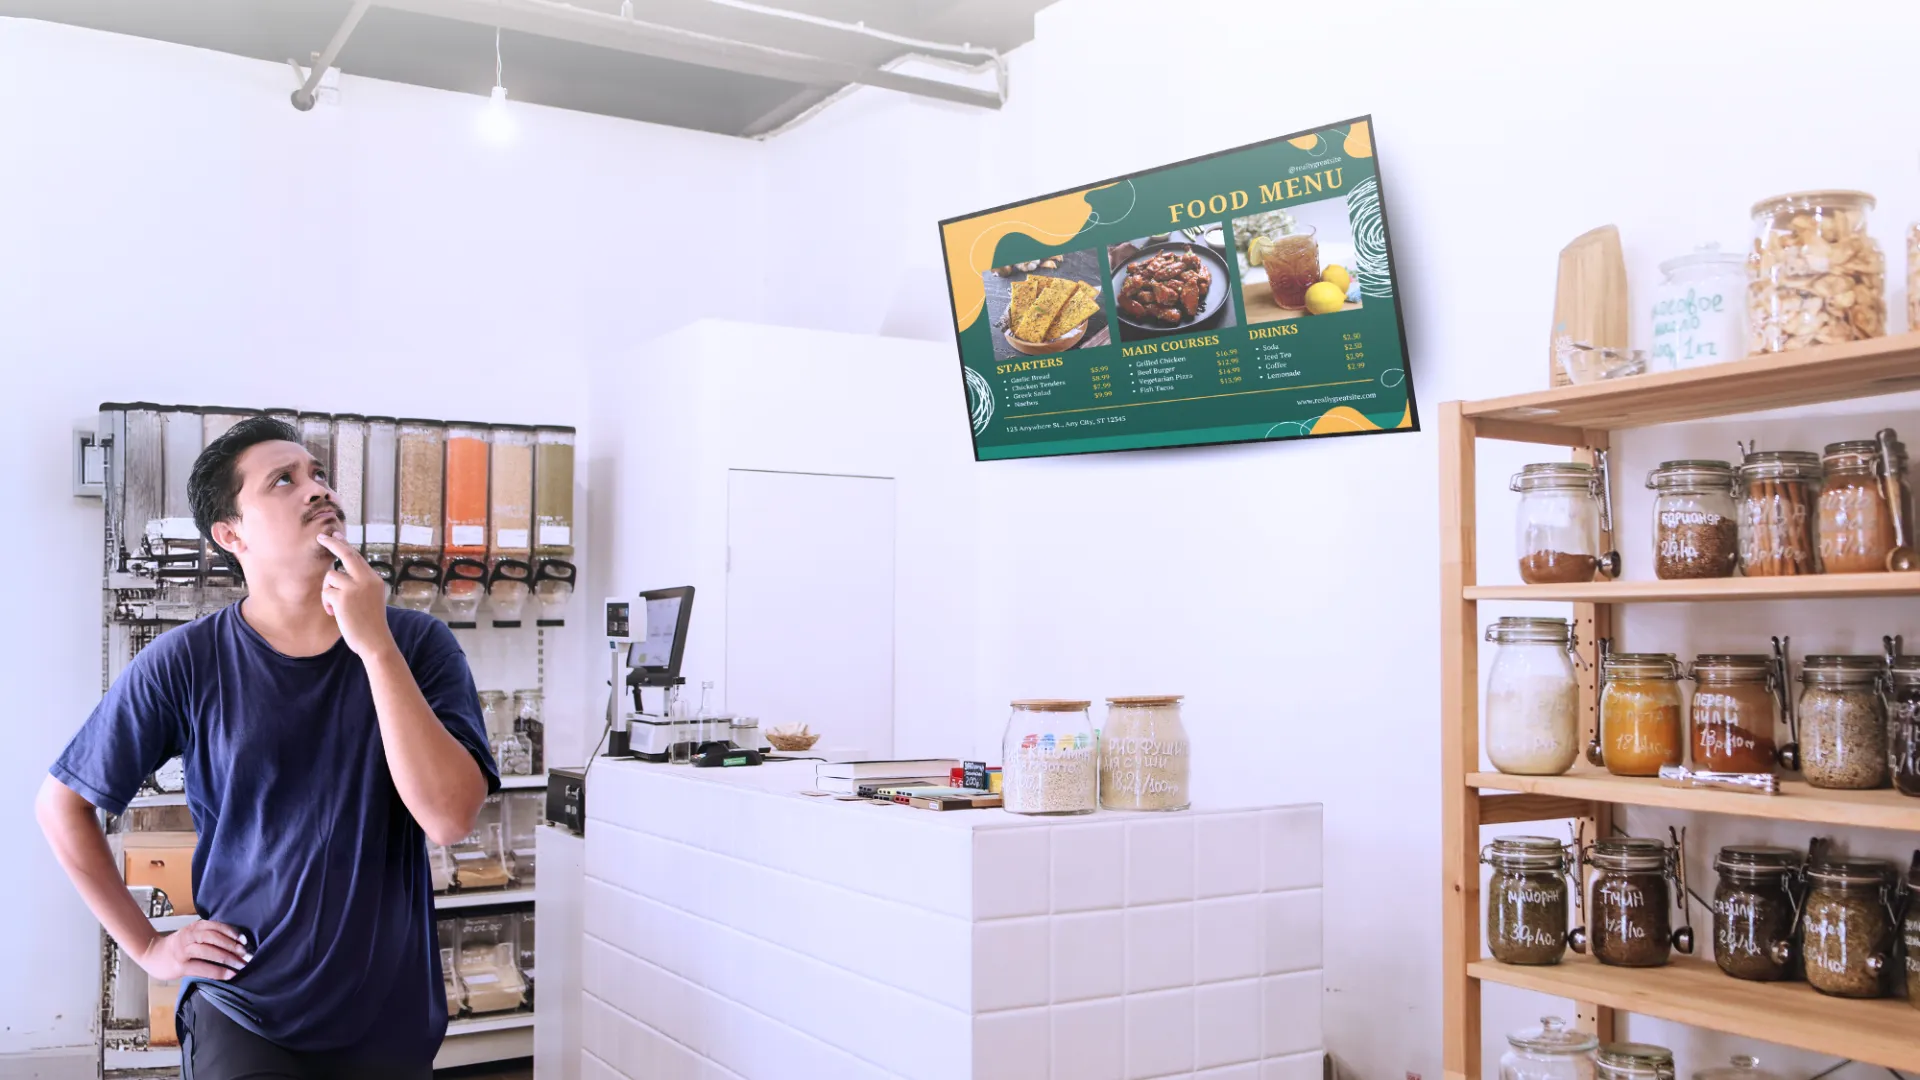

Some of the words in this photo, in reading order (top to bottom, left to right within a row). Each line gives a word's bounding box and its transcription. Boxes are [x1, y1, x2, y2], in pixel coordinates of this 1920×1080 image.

[1288, 156, 1342, 174] @reallygreatsite
[1168, 190, 1249, 223] FOOD
[1258, 167, 1343, 205] MENU
[1248, 323, 1299, 340] DRINKS
[1121, 343, 1158, 357] MAIN
[1161, 335, 1220, 352] COURSES
[1262, 343, 1280, 352] Soda
[1136, 359, 1158, 368] Grilled
[1159, 355, 1186, 365] Chicken
[1215, 348, 1238, 358] $16.99
[1264, 353, 1279, 361] Iced
[1279, 351, 1292, 359] Tea
[996, 357, 1064, 375] STARTERS
[1137, 368, 1153, 376] Beef
[1153, 366, 1176, 376] Burger
[1265, 362, 1288, 370] Coffee
[1010, 376, 1030, 384] Garlic
[1031, 373, 1051, 381] Bread
[1090, 365, 1109, 374] $5.99
[1138, 375, 1174, 386] Vegetarian
[1175, 373, 1194, 381] Pizza
[1267, 370, 1301, 380] Lemonade
[1012, 384, 1039, 392] Chicken
[1040, 380, 1066, 389] Tenders
[1139, 385, 1154, 393] Fish
[1013, 392, 1033, 400] Greek
[1033, 389, 1052, 397] Salad
[1296, 392, 1377, 406] www.reallygreatsite.com
[1014, 400, 1039, 408] Nachos
[1019, 423, 1052, 432] Anywhere
[1106, 415, 1127, 423] 12345
[1599, 889, 1645, 908] ТМИН
